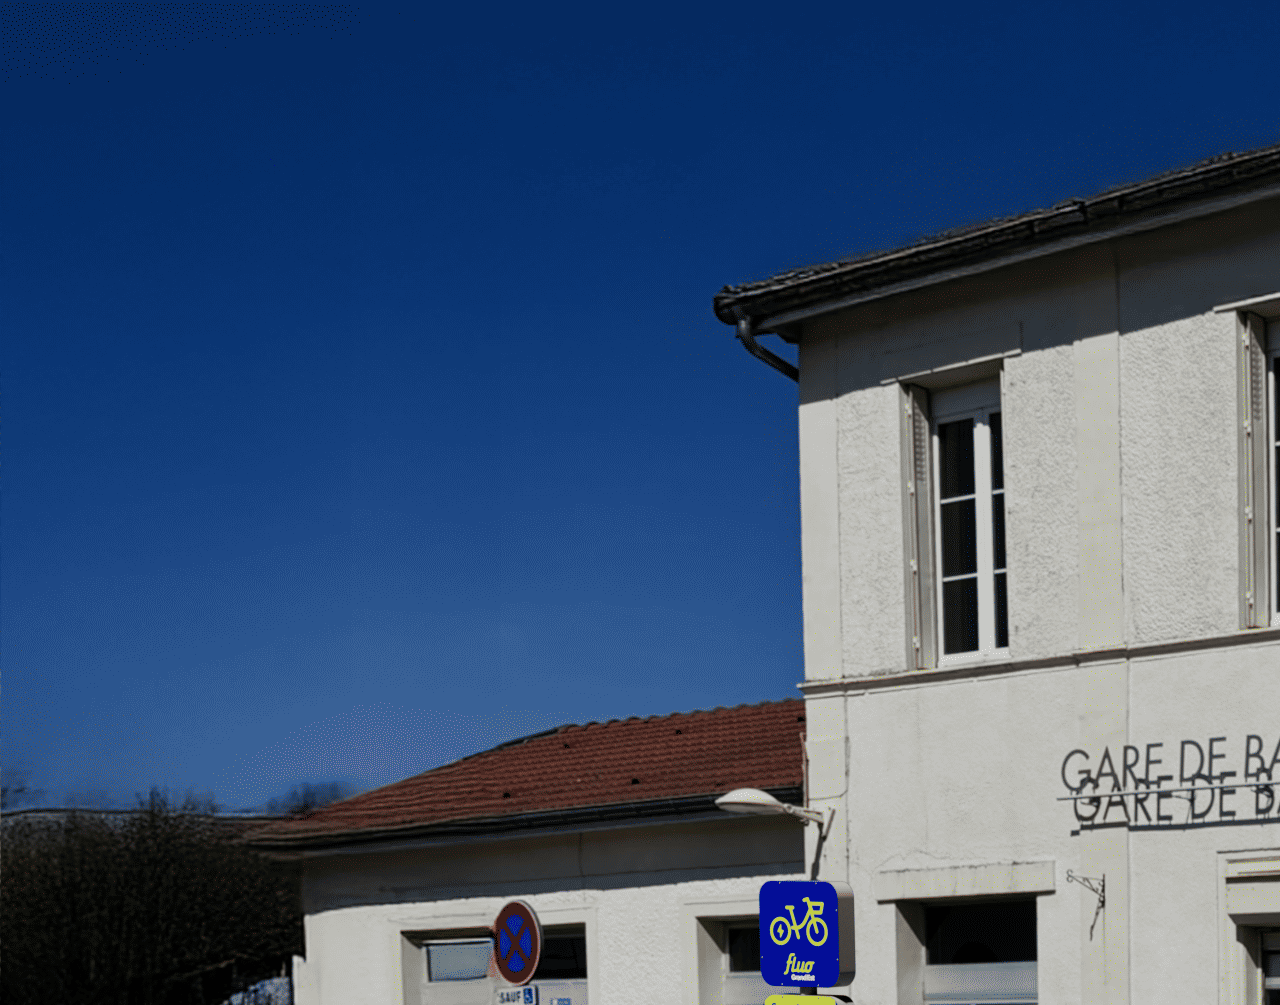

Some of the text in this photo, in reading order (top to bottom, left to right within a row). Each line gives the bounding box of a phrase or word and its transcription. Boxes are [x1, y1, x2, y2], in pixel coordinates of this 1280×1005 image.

[1061, 740, 1165, 793] GARE
[1180, 736, 1228, 783] DE
[784, 952, 815, 975] fluo
[499, 991, 521, 1004] SAUF
